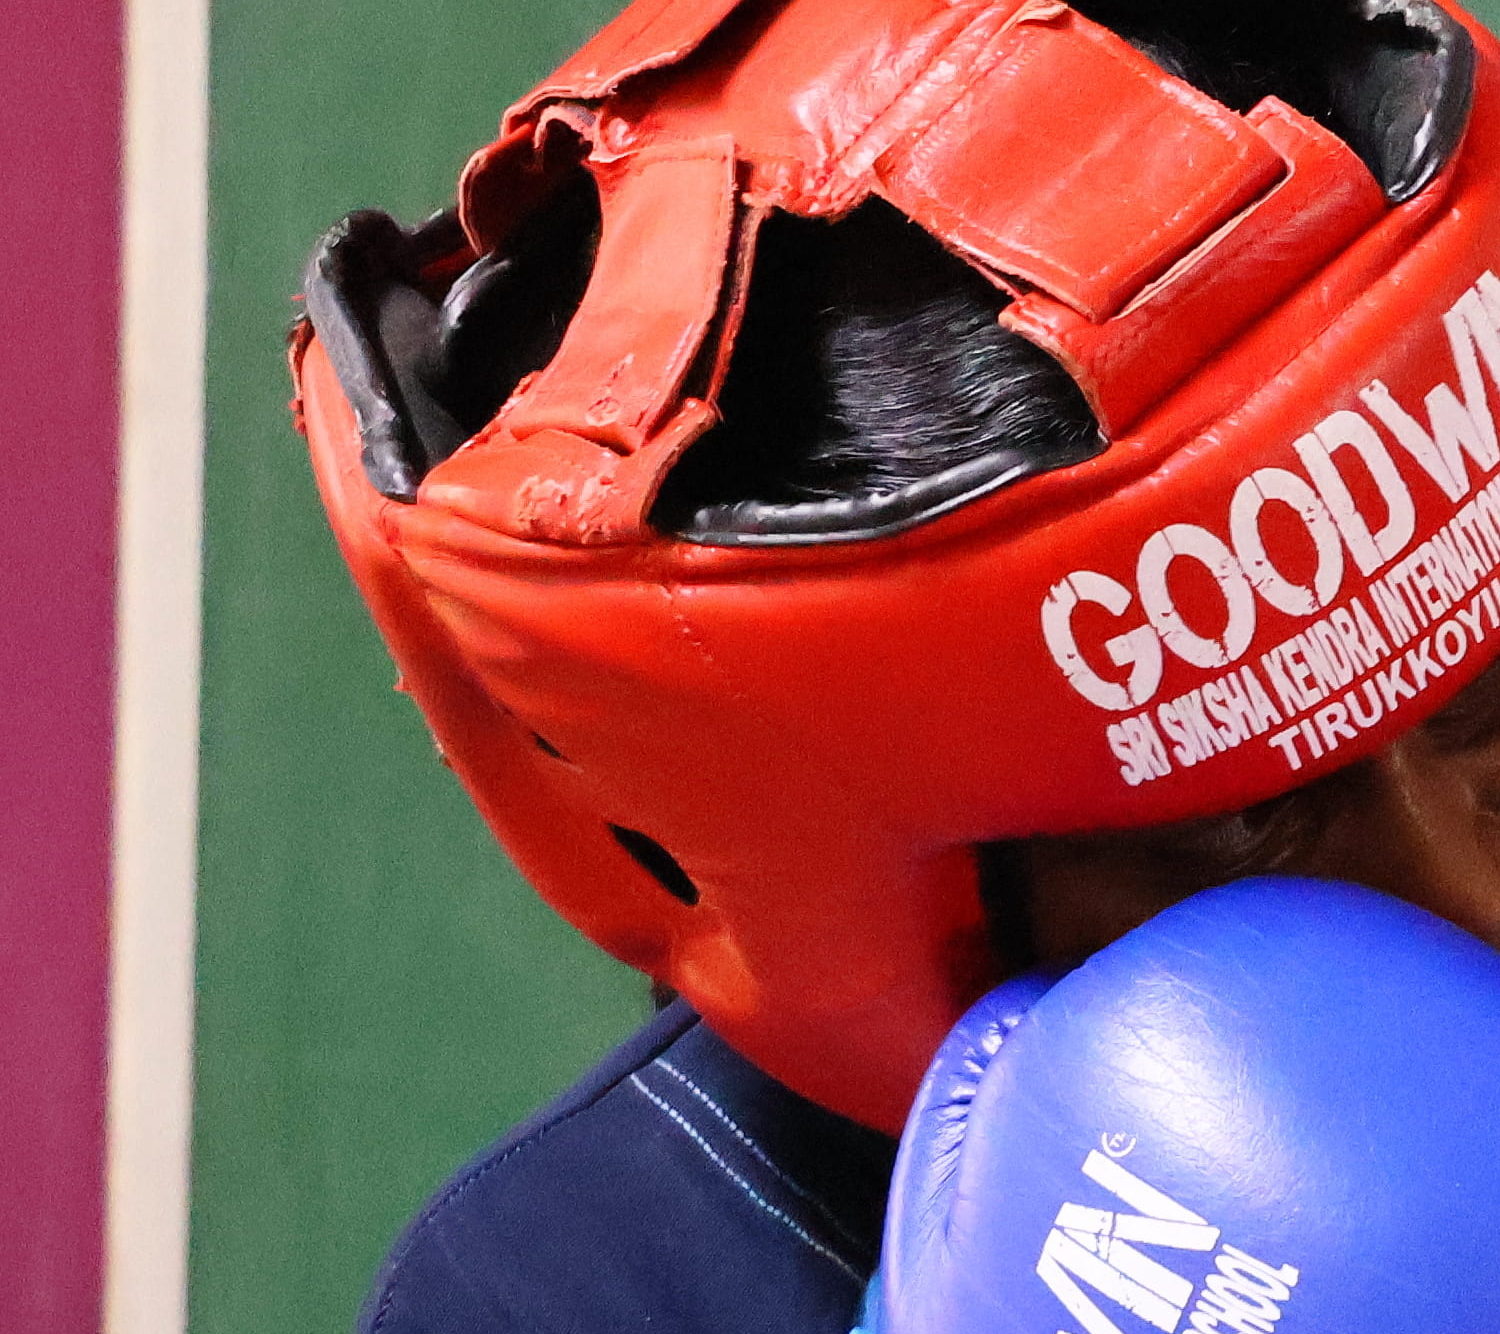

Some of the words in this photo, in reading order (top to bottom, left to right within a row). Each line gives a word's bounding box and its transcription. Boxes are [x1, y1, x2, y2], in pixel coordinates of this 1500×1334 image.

[1106, 706, 1170, 786] SRI
[1157, 666, 1283, 767] SIKSHA
[1260, 608, 1390, 722] KENDRA
